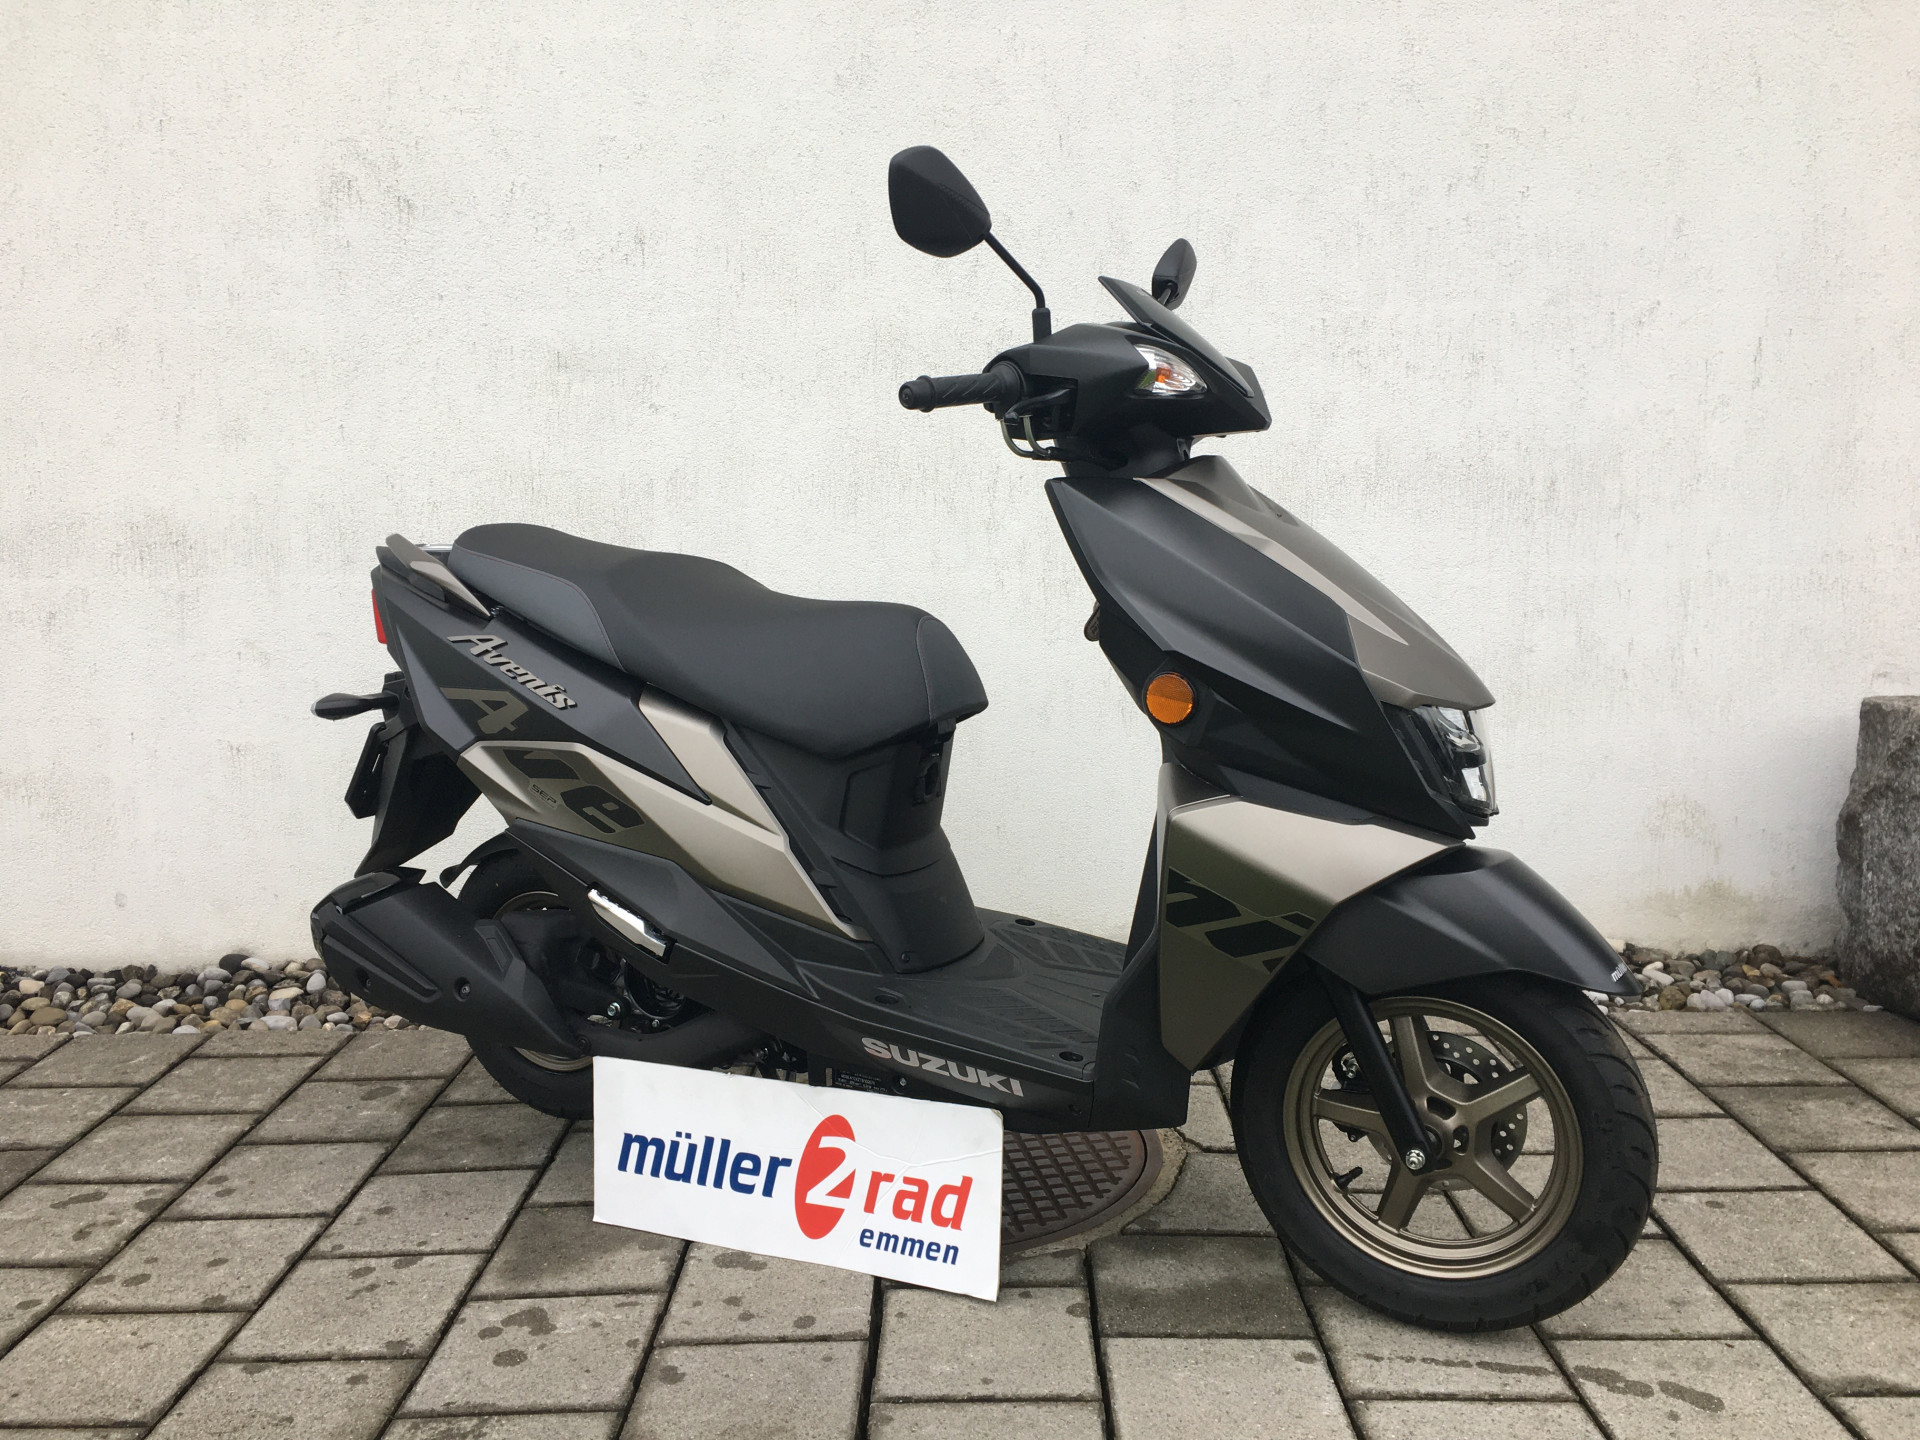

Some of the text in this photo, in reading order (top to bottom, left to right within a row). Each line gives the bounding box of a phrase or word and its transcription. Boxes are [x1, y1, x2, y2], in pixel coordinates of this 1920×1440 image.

[447, 634, 578, 711] Avenis
[531, 783, 557, 804] SEP
[861, 1037, 1024, 1097] SUZUKI
[617, 1131, 792, 1198] müller
[859, 1228, 960, 1266] emmen
